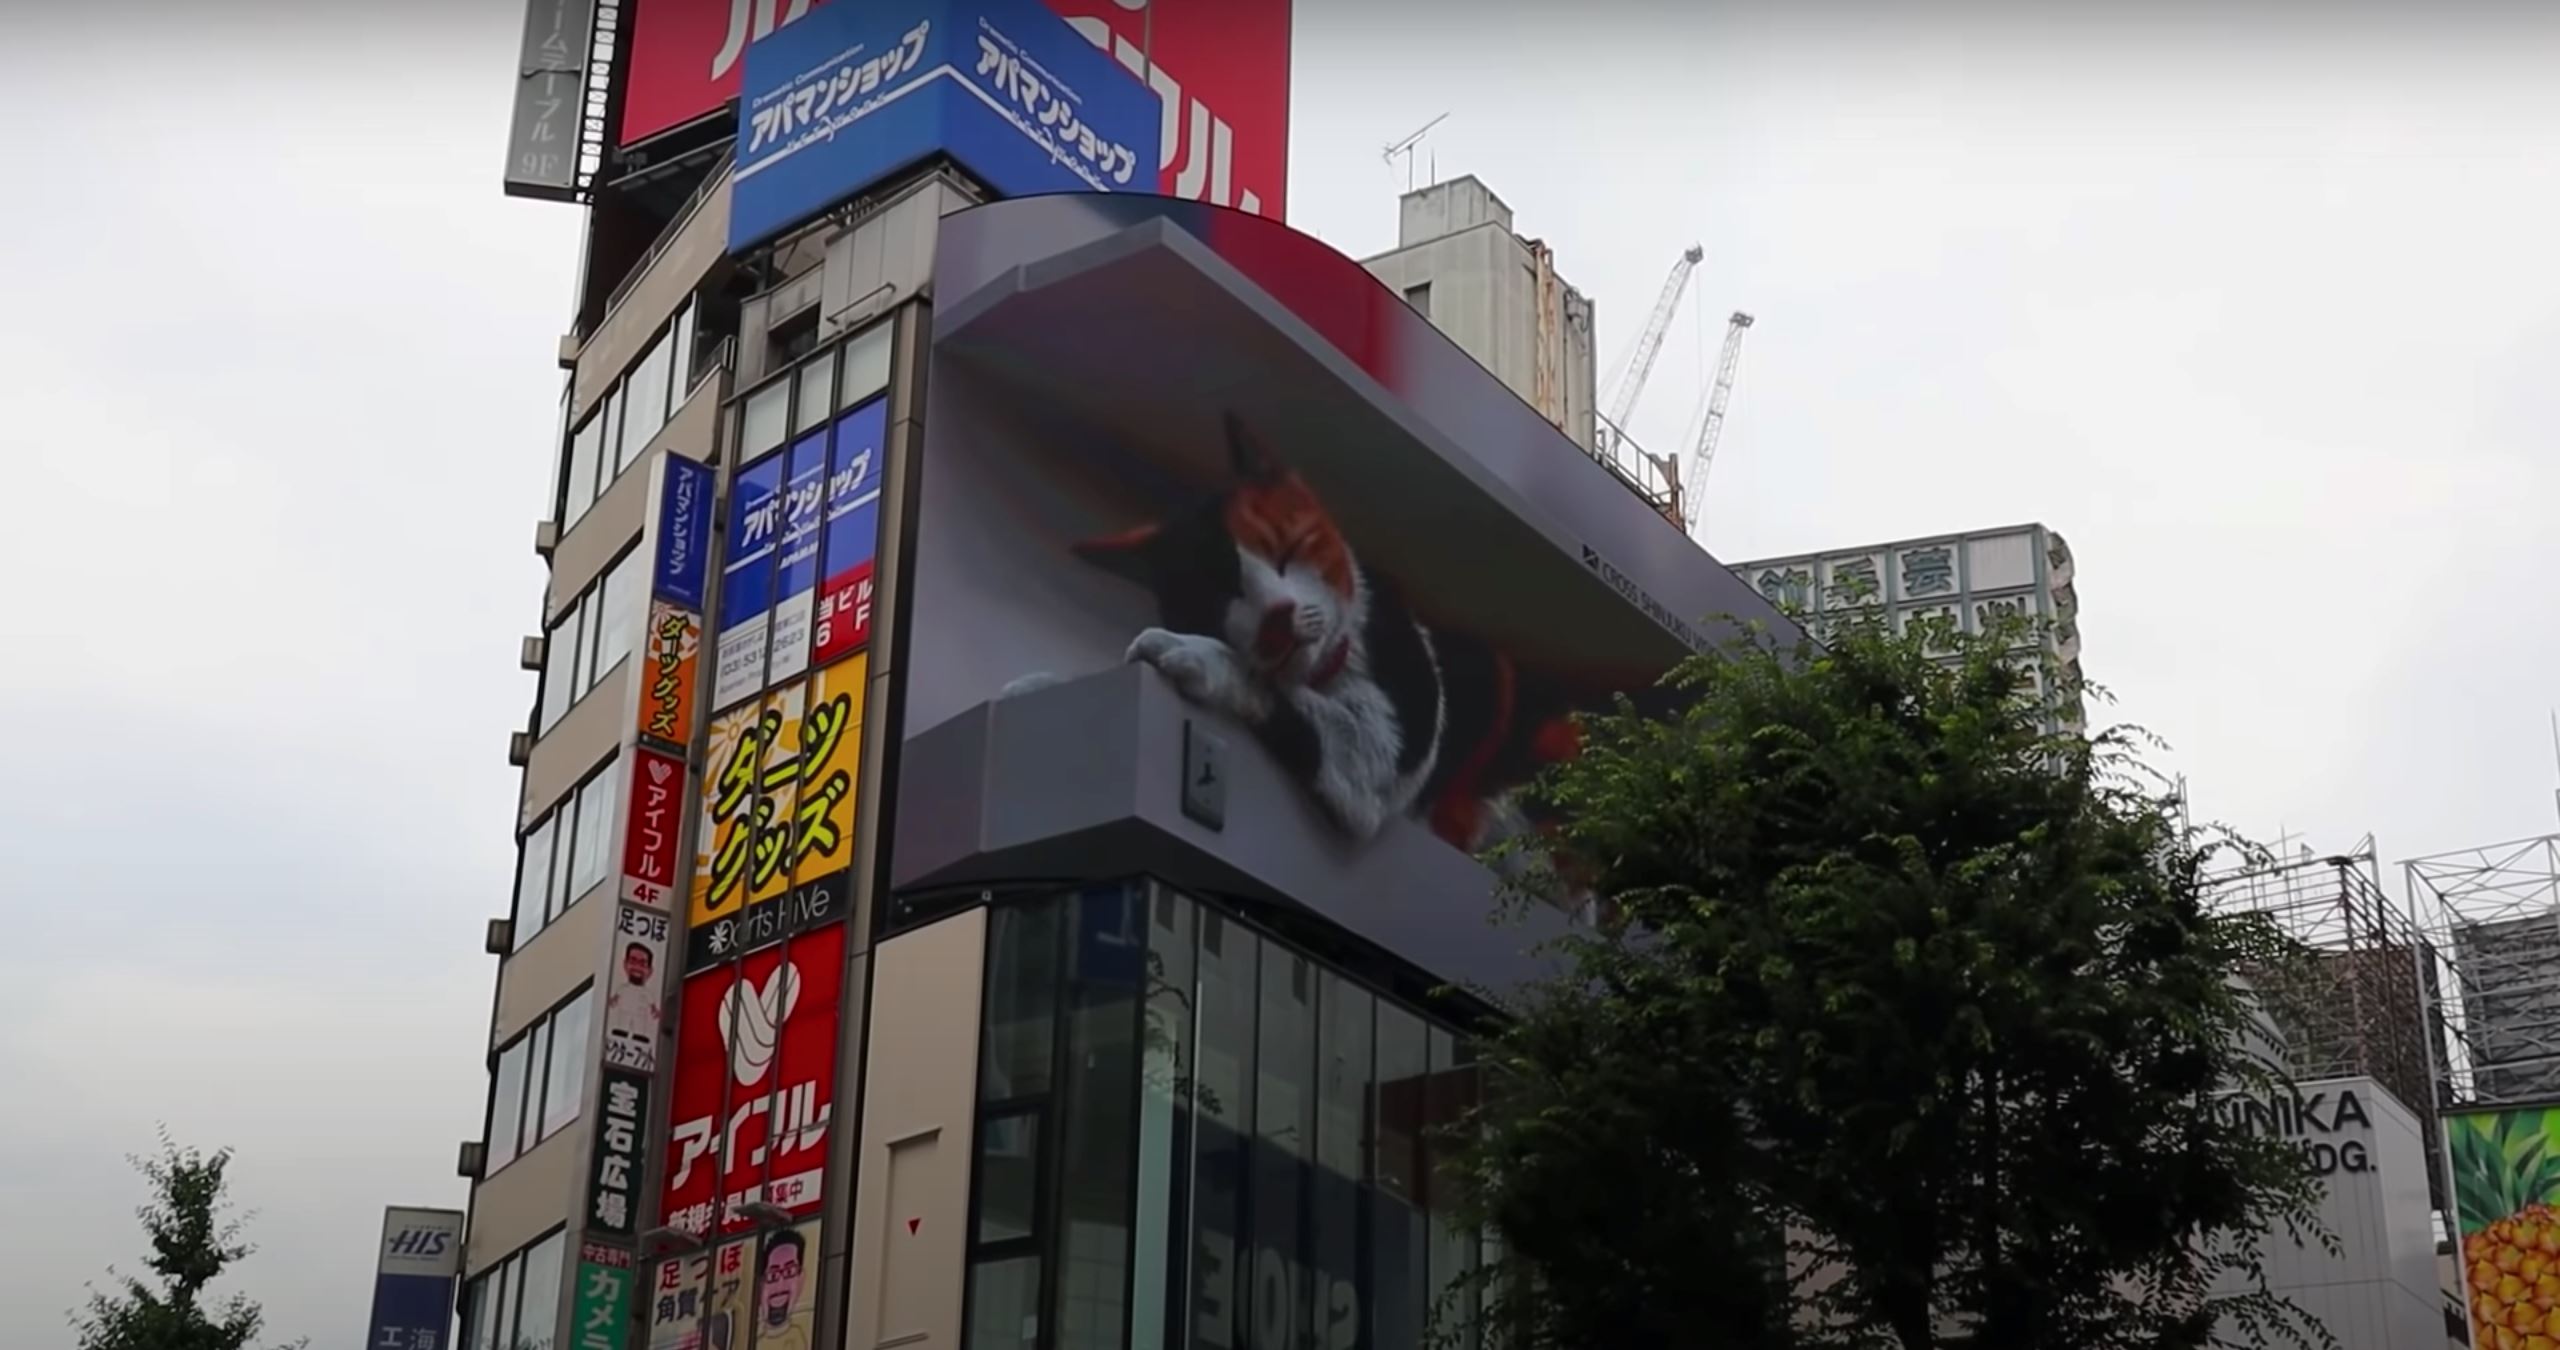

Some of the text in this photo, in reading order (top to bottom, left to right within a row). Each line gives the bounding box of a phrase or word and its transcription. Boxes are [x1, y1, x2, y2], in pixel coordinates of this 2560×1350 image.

[749, 19, 930, 153] アパマンショップ
[976, 34, 1137, 184] アパマンショップ
[669, 465, 694, 576] アパマンショップ
[741, 448, 872, 548] アパンシップ
[817, 579, 874, 622] 当ビル
[648, 614, 691, 736] ダーツグッズ
[714, 697, 849, 820] ダーツ
[638, 784, 668, 878] アイフル
[707, 773, 847, 907] グッズ
[633, 883, 660, 903] 4F
[596, 1081, 638, 1229] 宝石広場
[671, 1080, 833, 1191] アイフル
[388, 1229, 452, 1256] HIS
[581, 1269, 621, 1350] カメラ
